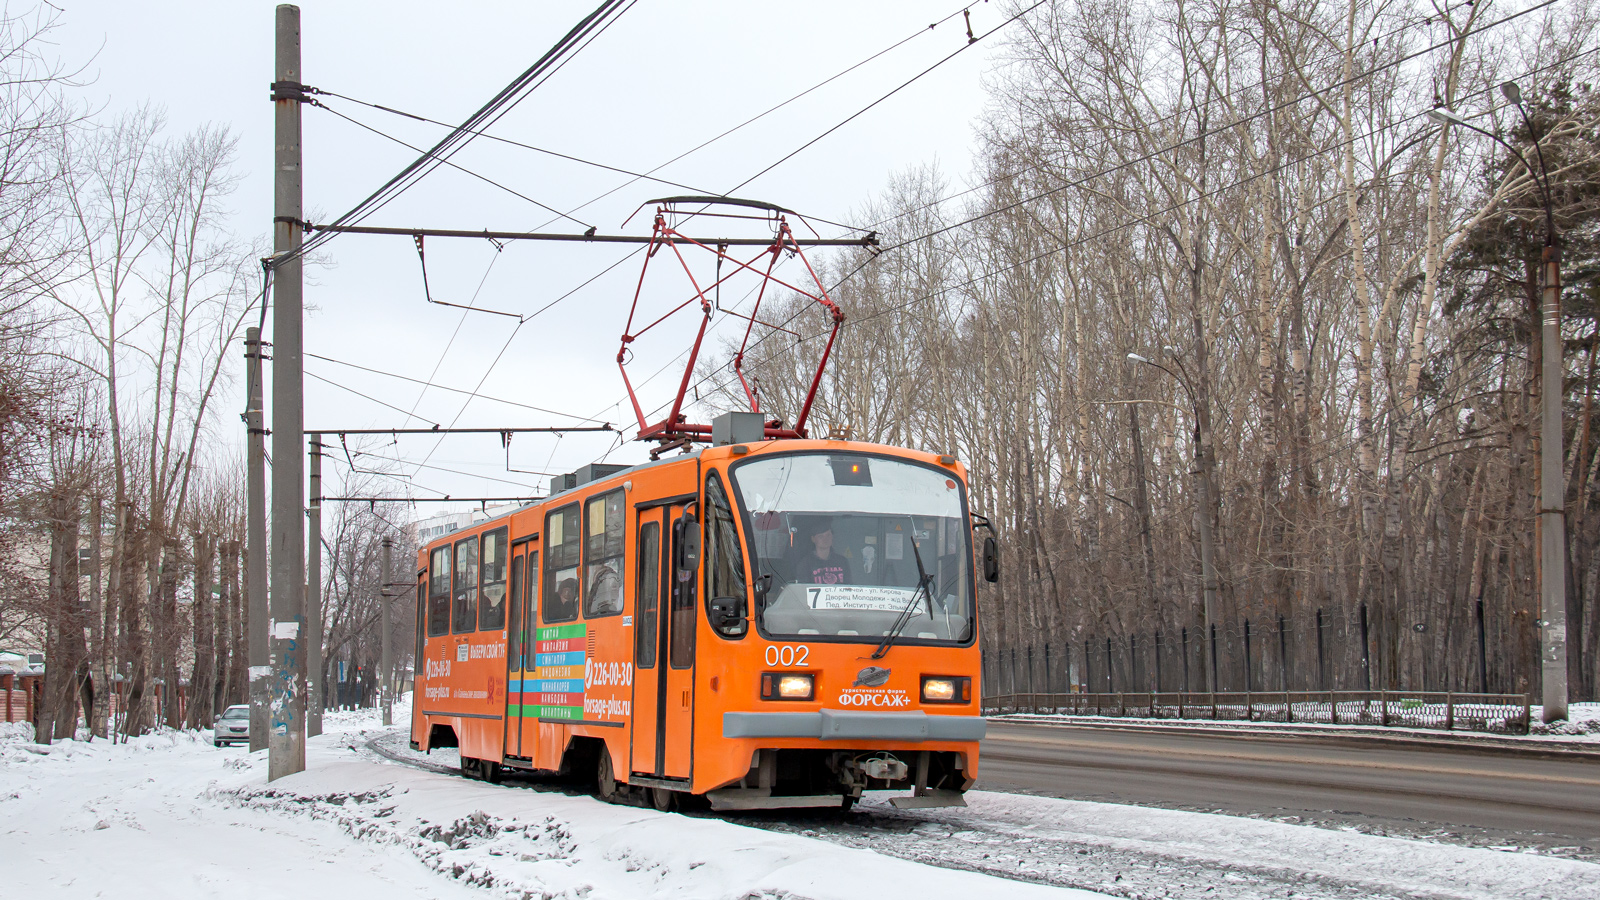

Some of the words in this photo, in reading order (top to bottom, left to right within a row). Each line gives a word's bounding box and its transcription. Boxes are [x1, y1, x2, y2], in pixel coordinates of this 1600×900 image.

[809, 588, 821, 608] 7
[543, 627, 559, 639] КИТАЙ
[543, 640, 568, 652] МАЛАЙЗИЯ
[542, 654, 566, 665] СИНГАПУР
[765, 645, 809, 667] 002
[542, 666, 571, 678] ИНДОНЕЗИЯ
[593, 662, 632, 686] 226-00-30
[541, 693, 568, 705] КАМБОДЖА
[838, 694, 911, 707] ФОРСАЖ+
[584, 693, 630, 719] forsage-plus.ru
[541, 707, 571, 718] ФИЛИППИНЫ
